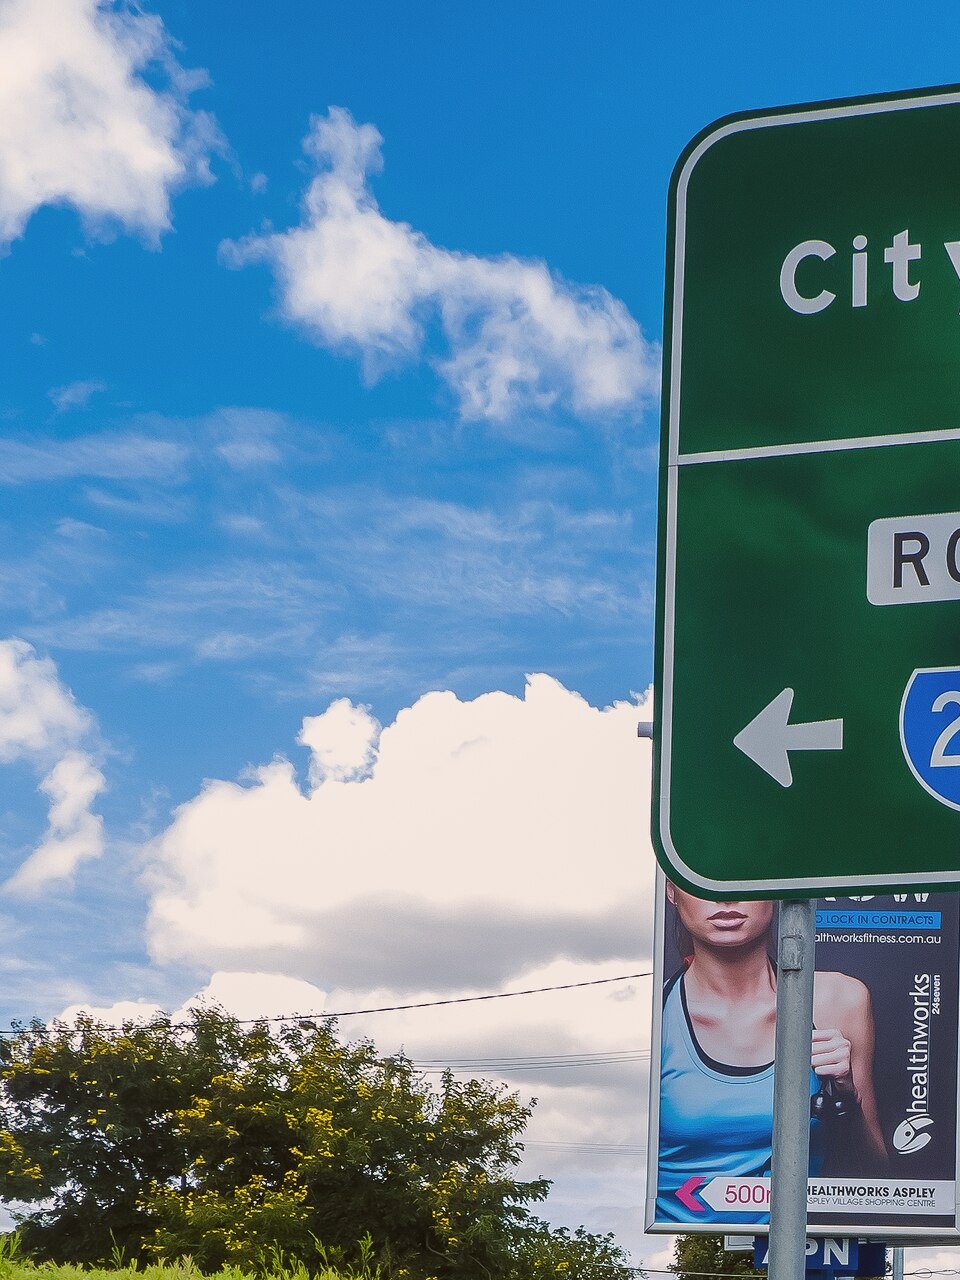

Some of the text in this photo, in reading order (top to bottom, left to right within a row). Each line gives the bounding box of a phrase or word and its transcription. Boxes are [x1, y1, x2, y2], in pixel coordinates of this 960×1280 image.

[827, 915, 854, 924] LOCK
[858, 916, 868, 924] IN
[872, 915, 934, 925] CONTRACTS
[815, 933, 942, 944] althworksfitness.com.au
[932, 974, 941, 1015] 24seven
[906, 973, 930, 1113] healthworks
[724, 1184, 771, 1204] 500
[893, 1187, 936, 1198] ASPLEY
[807, 1196, 936, 1208] SPLEY VILLAGE SHOPPING CENTRE
